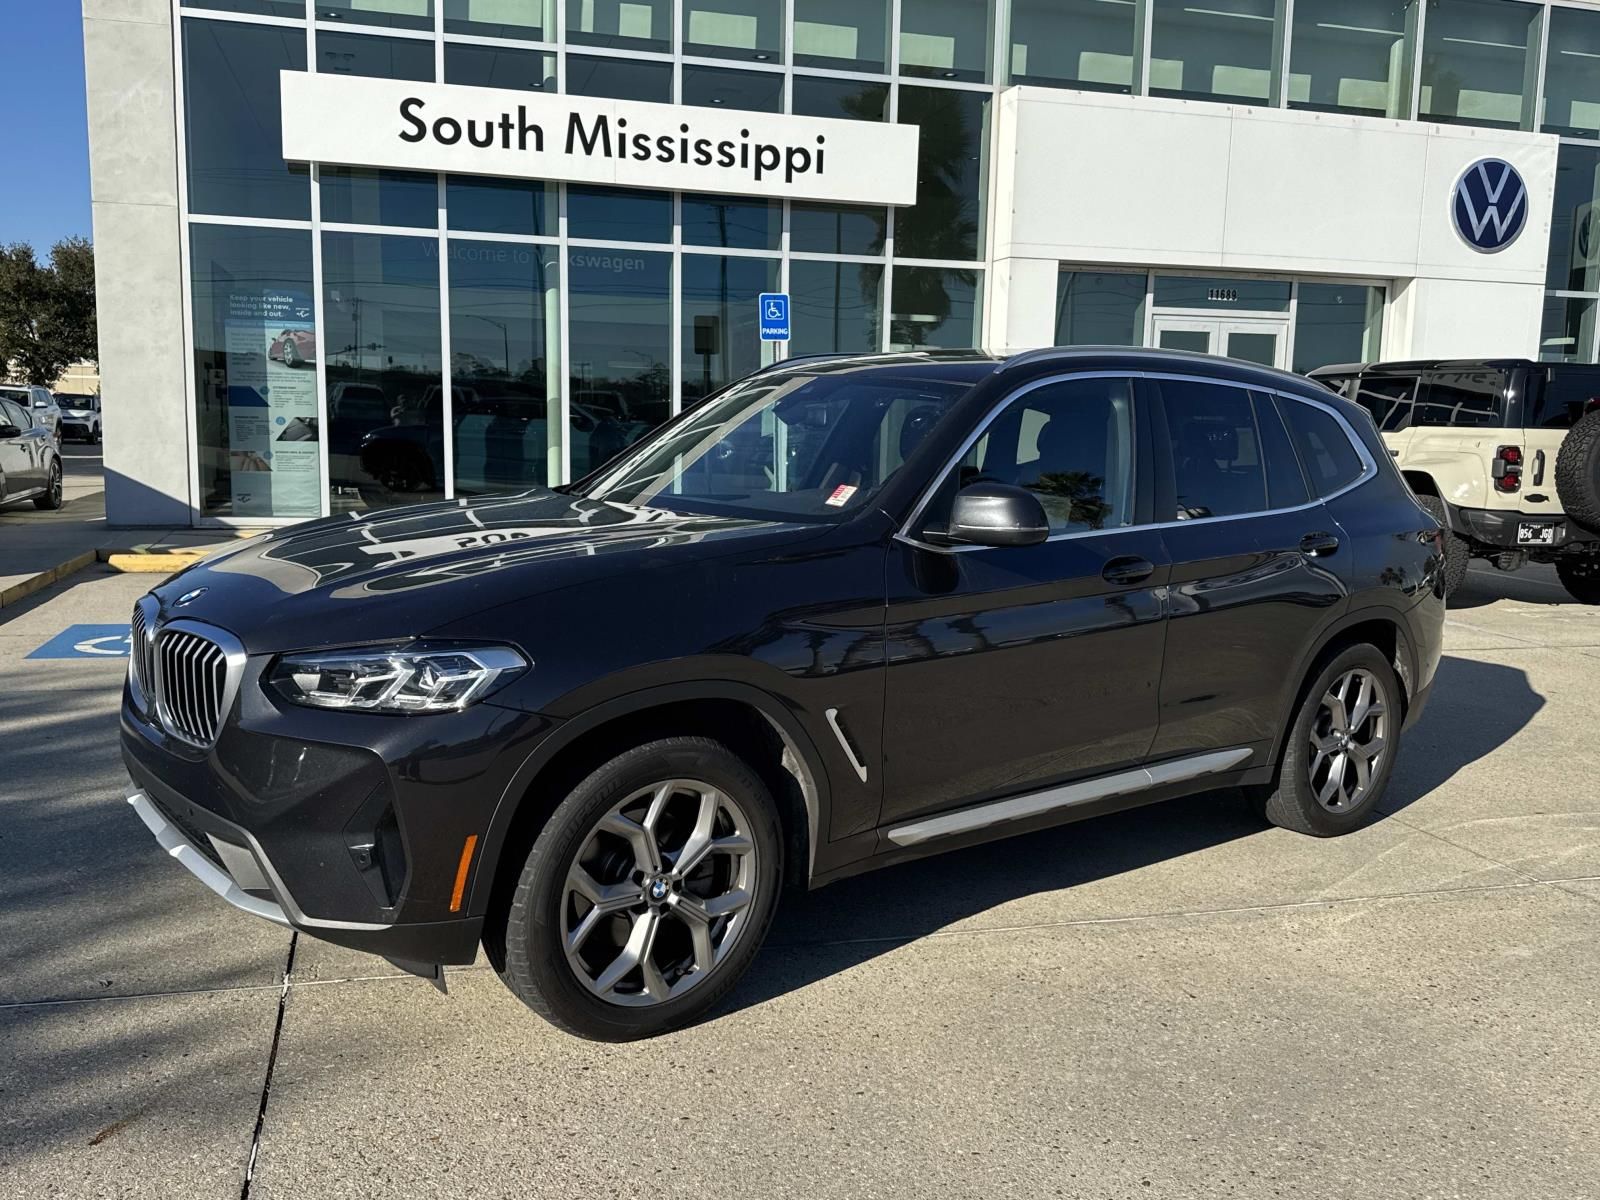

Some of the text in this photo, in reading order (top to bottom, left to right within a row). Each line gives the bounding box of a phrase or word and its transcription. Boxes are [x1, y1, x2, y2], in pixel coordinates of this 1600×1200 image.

[398, 97, 826, 184] South Mississippi
[512, 248, 530, 264] to
[539, 252, 645, 273] Vkswagen
[268, 295, 294, 303] vehicle
[762, 327, 788, 335] PARKING
